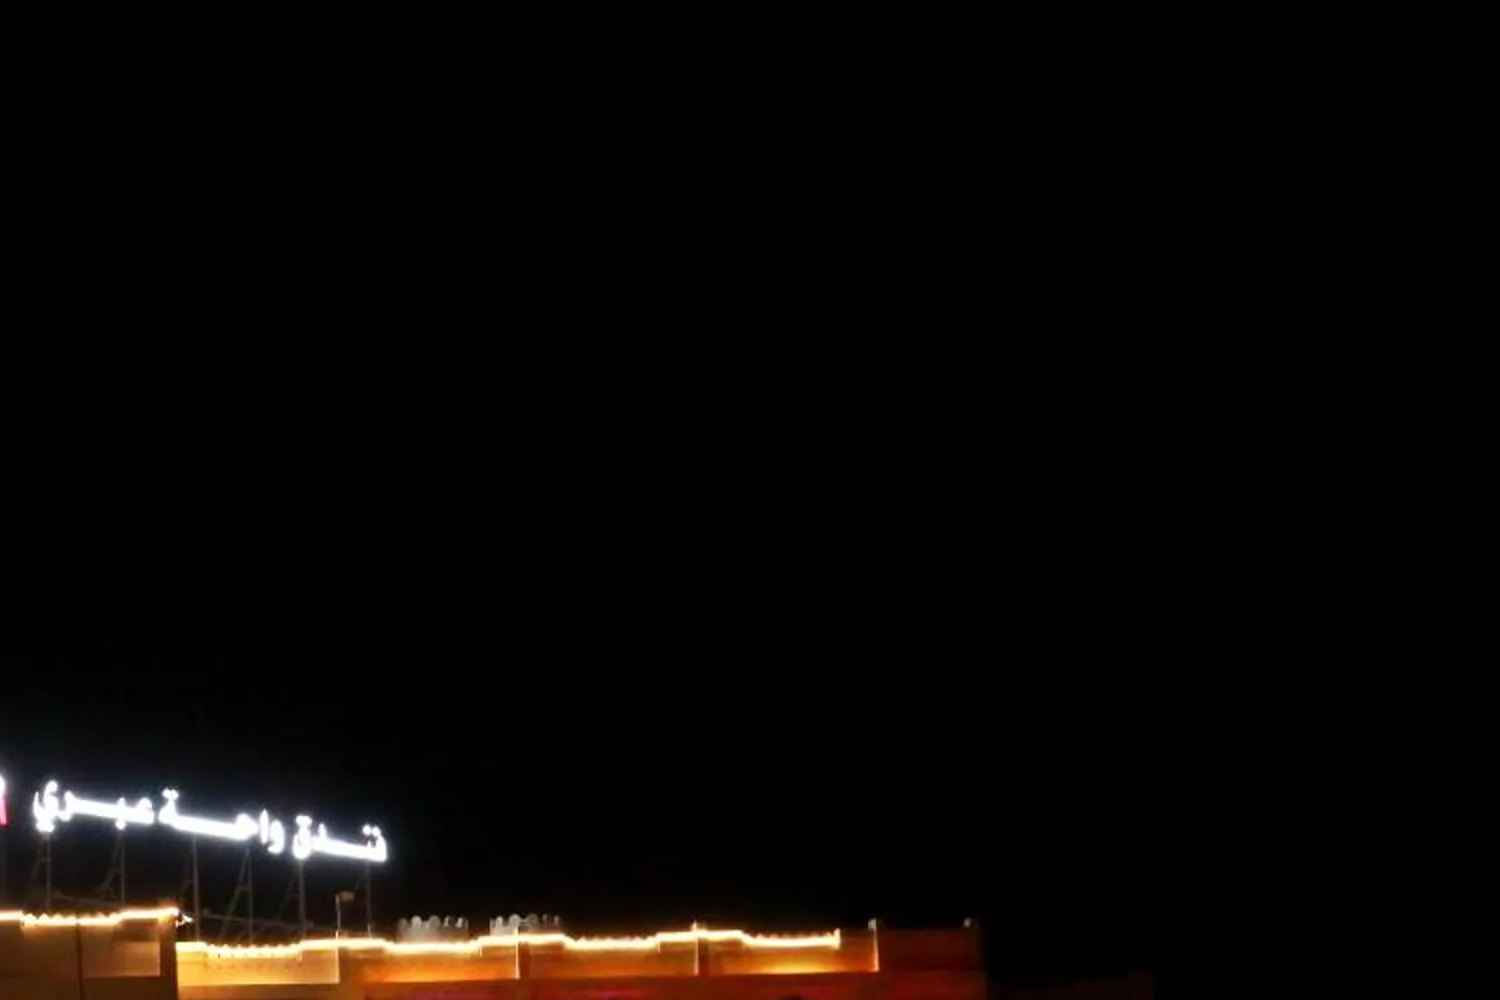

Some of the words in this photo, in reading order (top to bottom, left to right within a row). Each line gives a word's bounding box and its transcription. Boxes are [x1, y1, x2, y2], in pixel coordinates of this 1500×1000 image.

[33, 780, 155, 832] عبري
[158, 788, 285, 855] واحة
[292, 814, 387, 862] فندق
